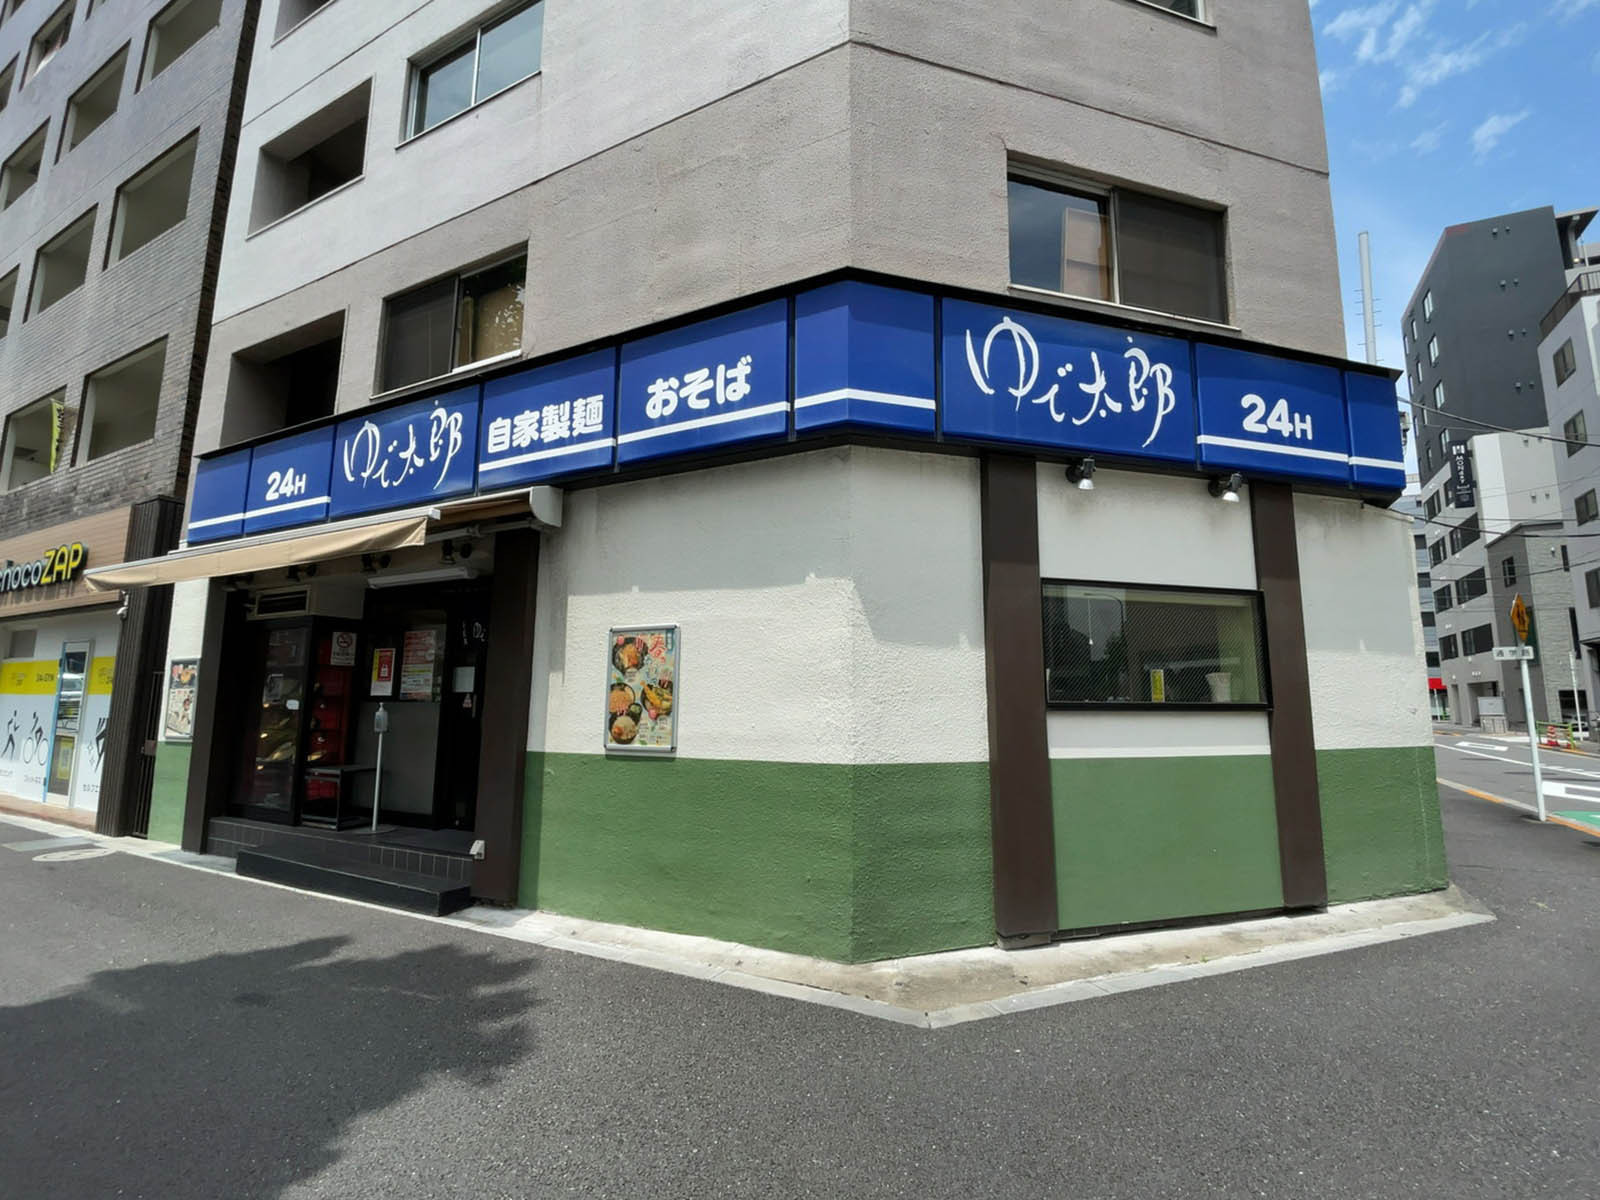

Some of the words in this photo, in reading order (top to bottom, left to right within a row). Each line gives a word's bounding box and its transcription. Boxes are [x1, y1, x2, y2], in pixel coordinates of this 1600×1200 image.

[645, 355, 753, 419] おそば
[965, 316, 1176, 448] ゆで太郎
[343, 400, 463, 490] ゆで太郎
[487, 394, 604, 454] 自家製麺
[1240, 393, 1313, 441] 24H
[265, 467, 307, 501] 24H
[0, 543, 84, 592] hocoZAP
